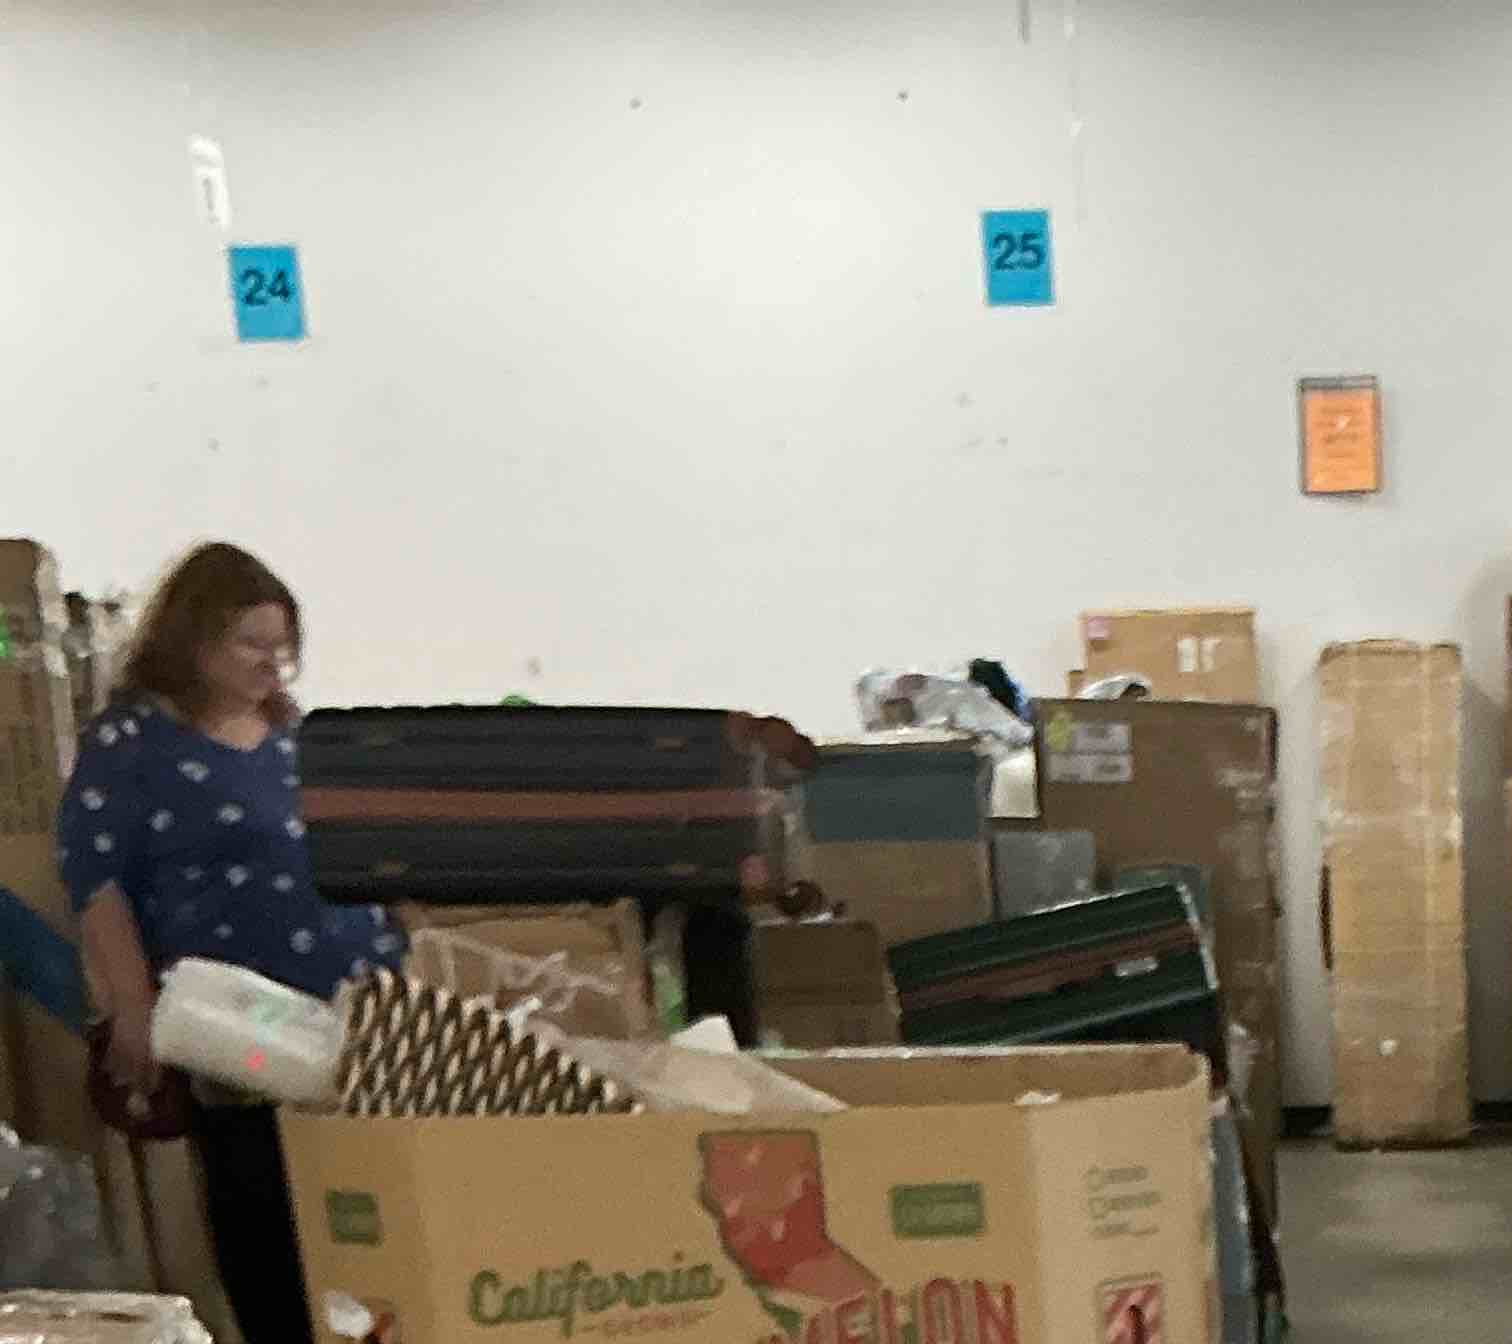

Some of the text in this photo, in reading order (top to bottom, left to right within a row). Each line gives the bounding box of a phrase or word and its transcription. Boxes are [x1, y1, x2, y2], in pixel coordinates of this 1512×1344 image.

[992, 232, 1042, 270] 25
[241, 268, 291, 306] 24
[468, 1249, 725, 1339] California
